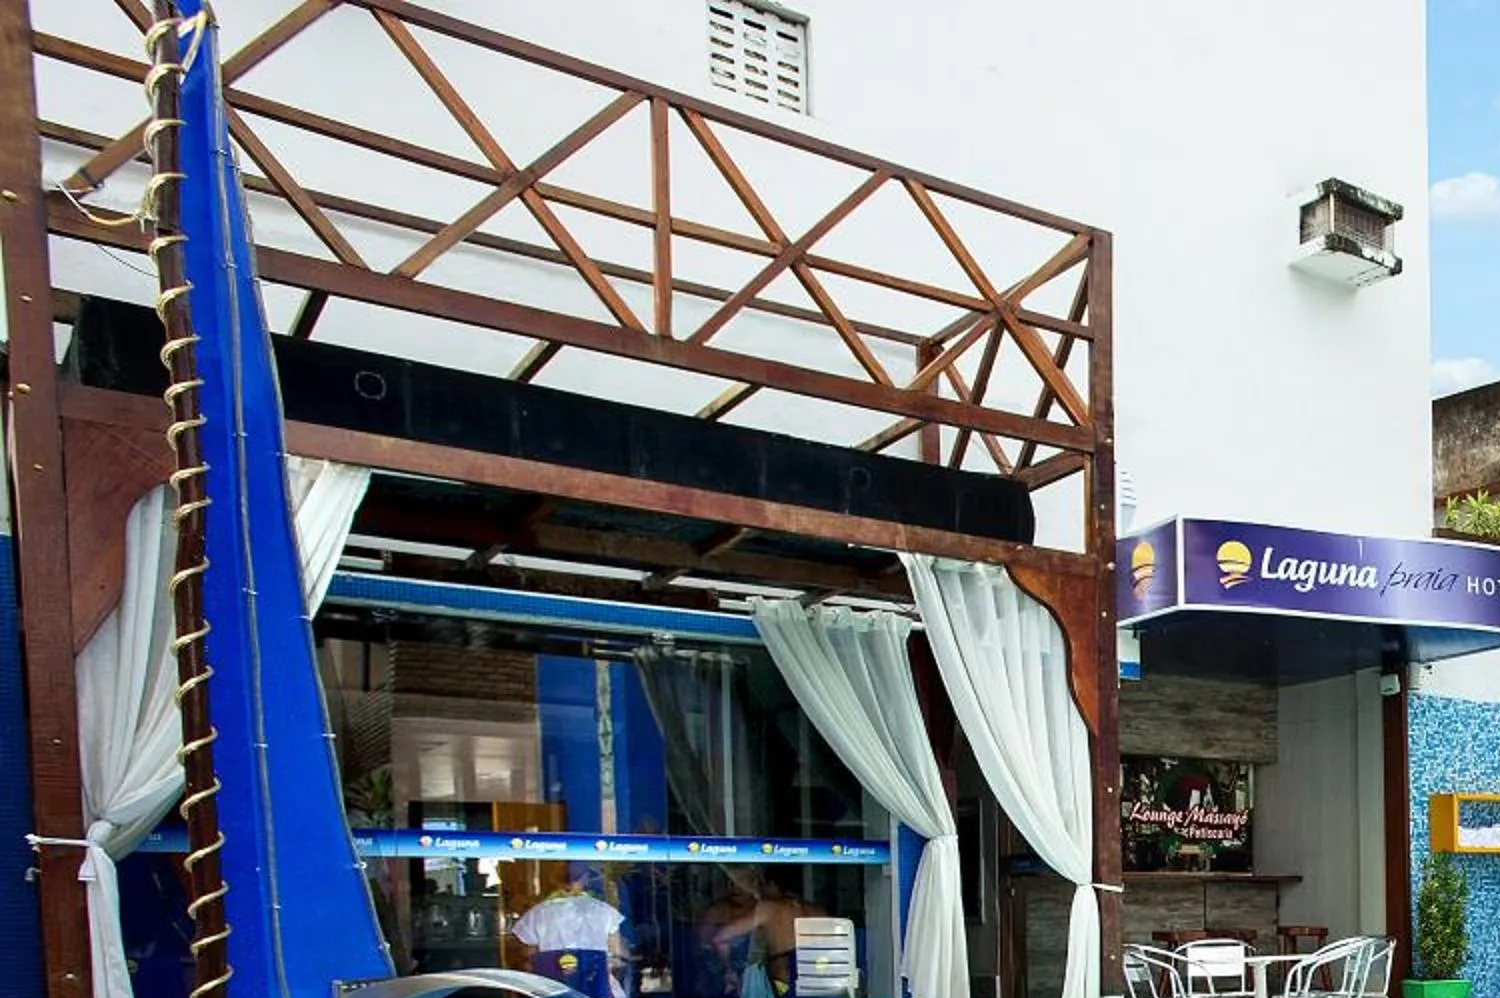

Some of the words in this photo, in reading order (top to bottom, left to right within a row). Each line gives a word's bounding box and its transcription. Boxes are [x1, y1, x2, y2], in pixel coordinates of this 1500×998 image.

[1261, 547, 1378, 592] Laguna
[1380, 561, 1459, 596] praia
[1130, 801, 1183, 828] Lounge
[435, 837, 480, 850] Laguna
